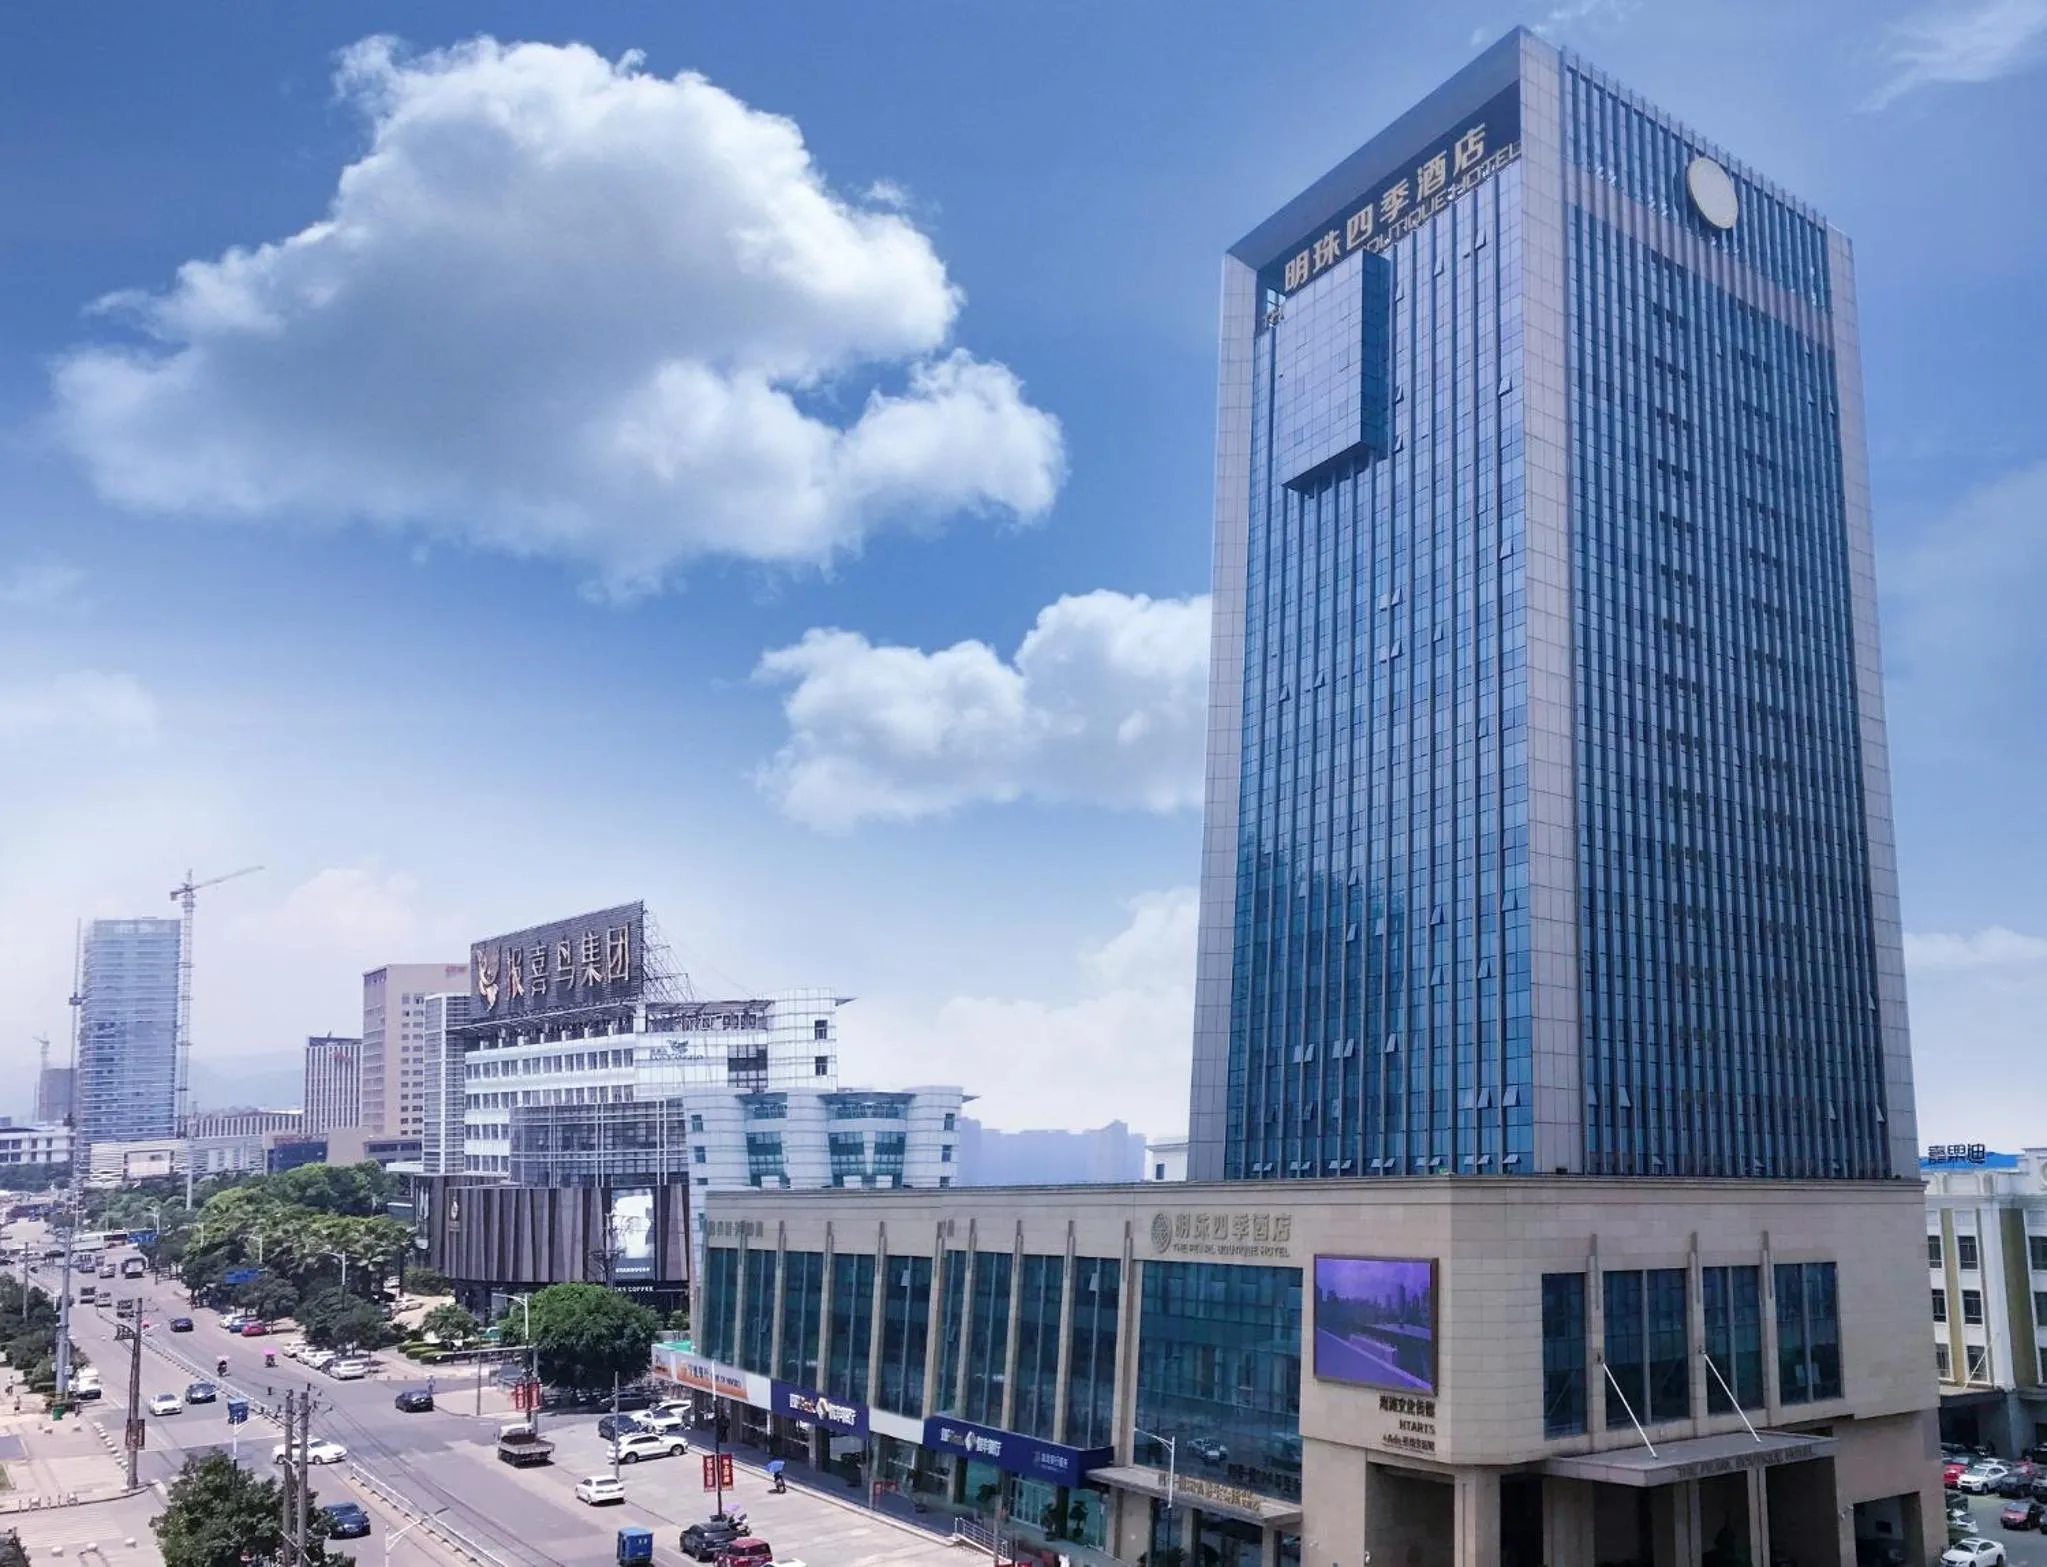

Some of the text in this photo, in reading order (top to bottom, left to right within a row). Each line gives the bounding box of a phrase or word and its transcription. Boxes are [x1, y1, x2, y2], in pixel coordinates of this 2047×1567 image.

[1284, 123, 1487, 291] 明珠四季酒店
[1363, 188, 1448, 252] OUTIQUE
[1175, 1213, 1292, 1241] 明珠四季酒店
